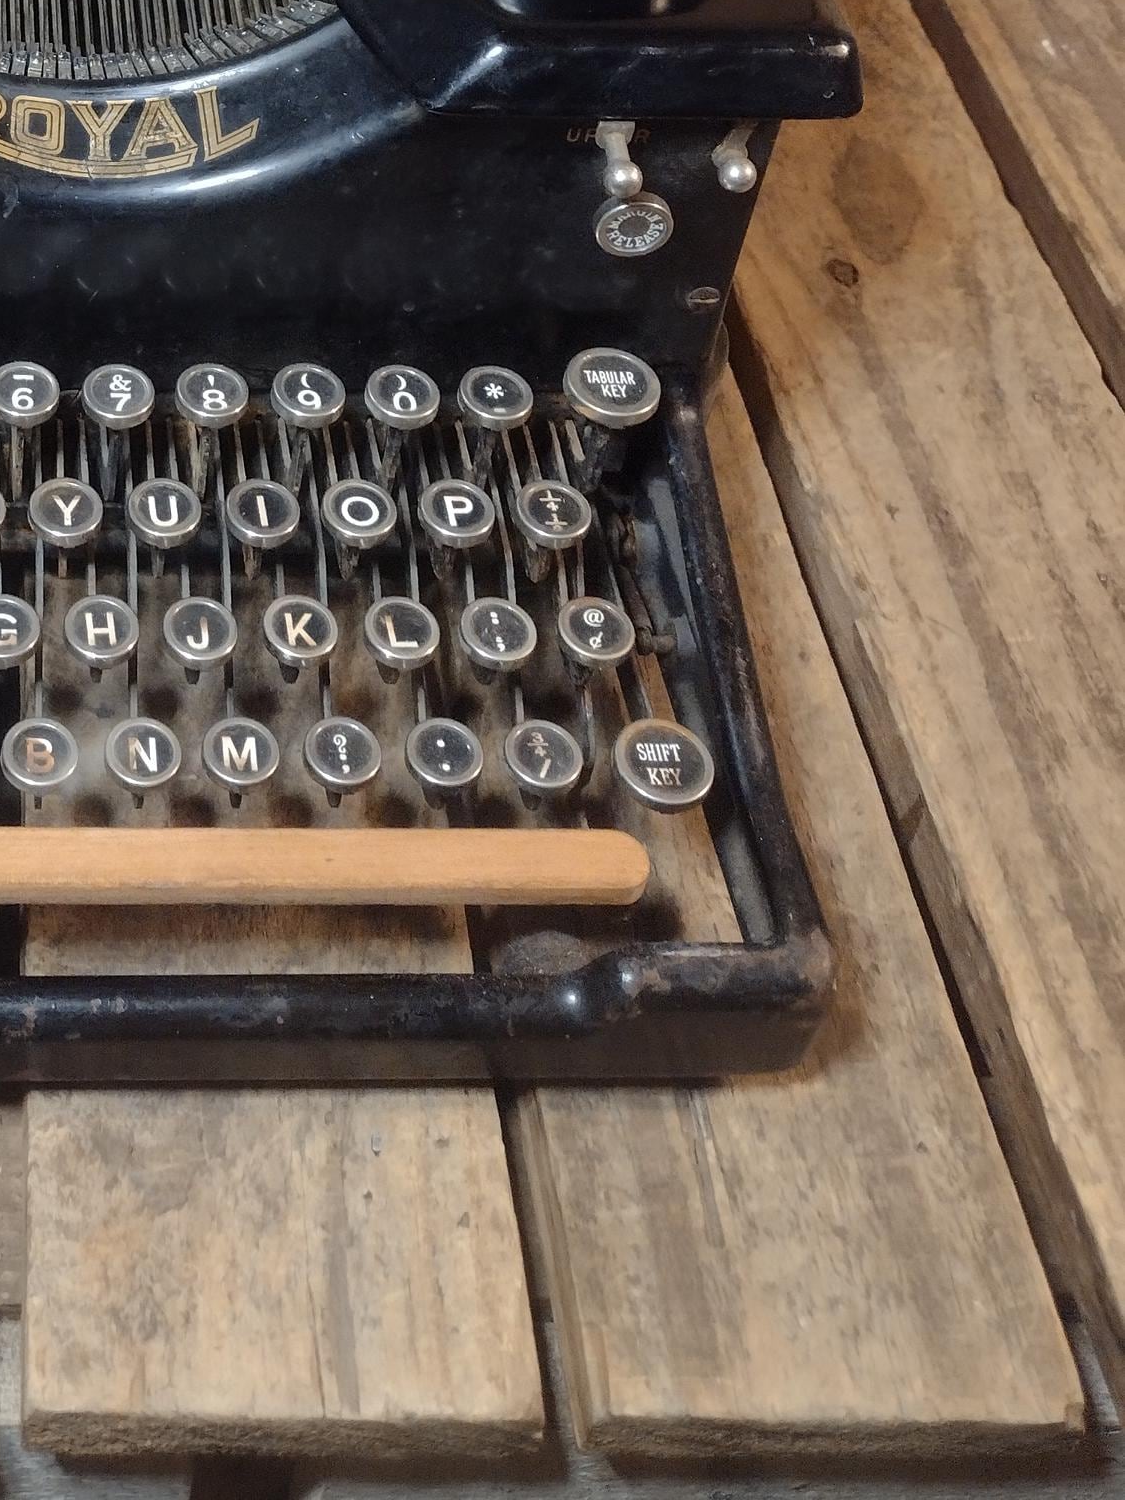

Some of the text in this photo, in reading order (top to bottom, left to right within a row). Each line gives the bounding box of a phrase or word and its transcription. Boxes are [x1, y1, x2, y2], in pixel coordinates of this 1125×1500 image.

[606, 222, 664, 248] RELEASE
[583, 368, 636, 388] TABULAR
[600, 383, 628, 399] KEY
[11, 387, 34, 410] 6
[110, 393, 131, 411] 7
[203, 389, 228, 411] 8
[297, 389, 321, 410] 9
[51, 495, 81, 526] Y
[147, 495, 179, 527] U
[255, 495, 269, 527] I
[341, 496, 380, 527] O
[442, 495, 473, 527] P
[84, 611, 117, 647] H
[186, 616, 209, 650] J
[284, 613, 317, 647] K
[384, 613, 419, 648] L
[25, 737, 55, 773] B
[128, 737, 158, 773] N
[221, 736, 259, 773] M
[635, 743, 681, 762] SHIFT
[646, 766, 682, 787] KEY
